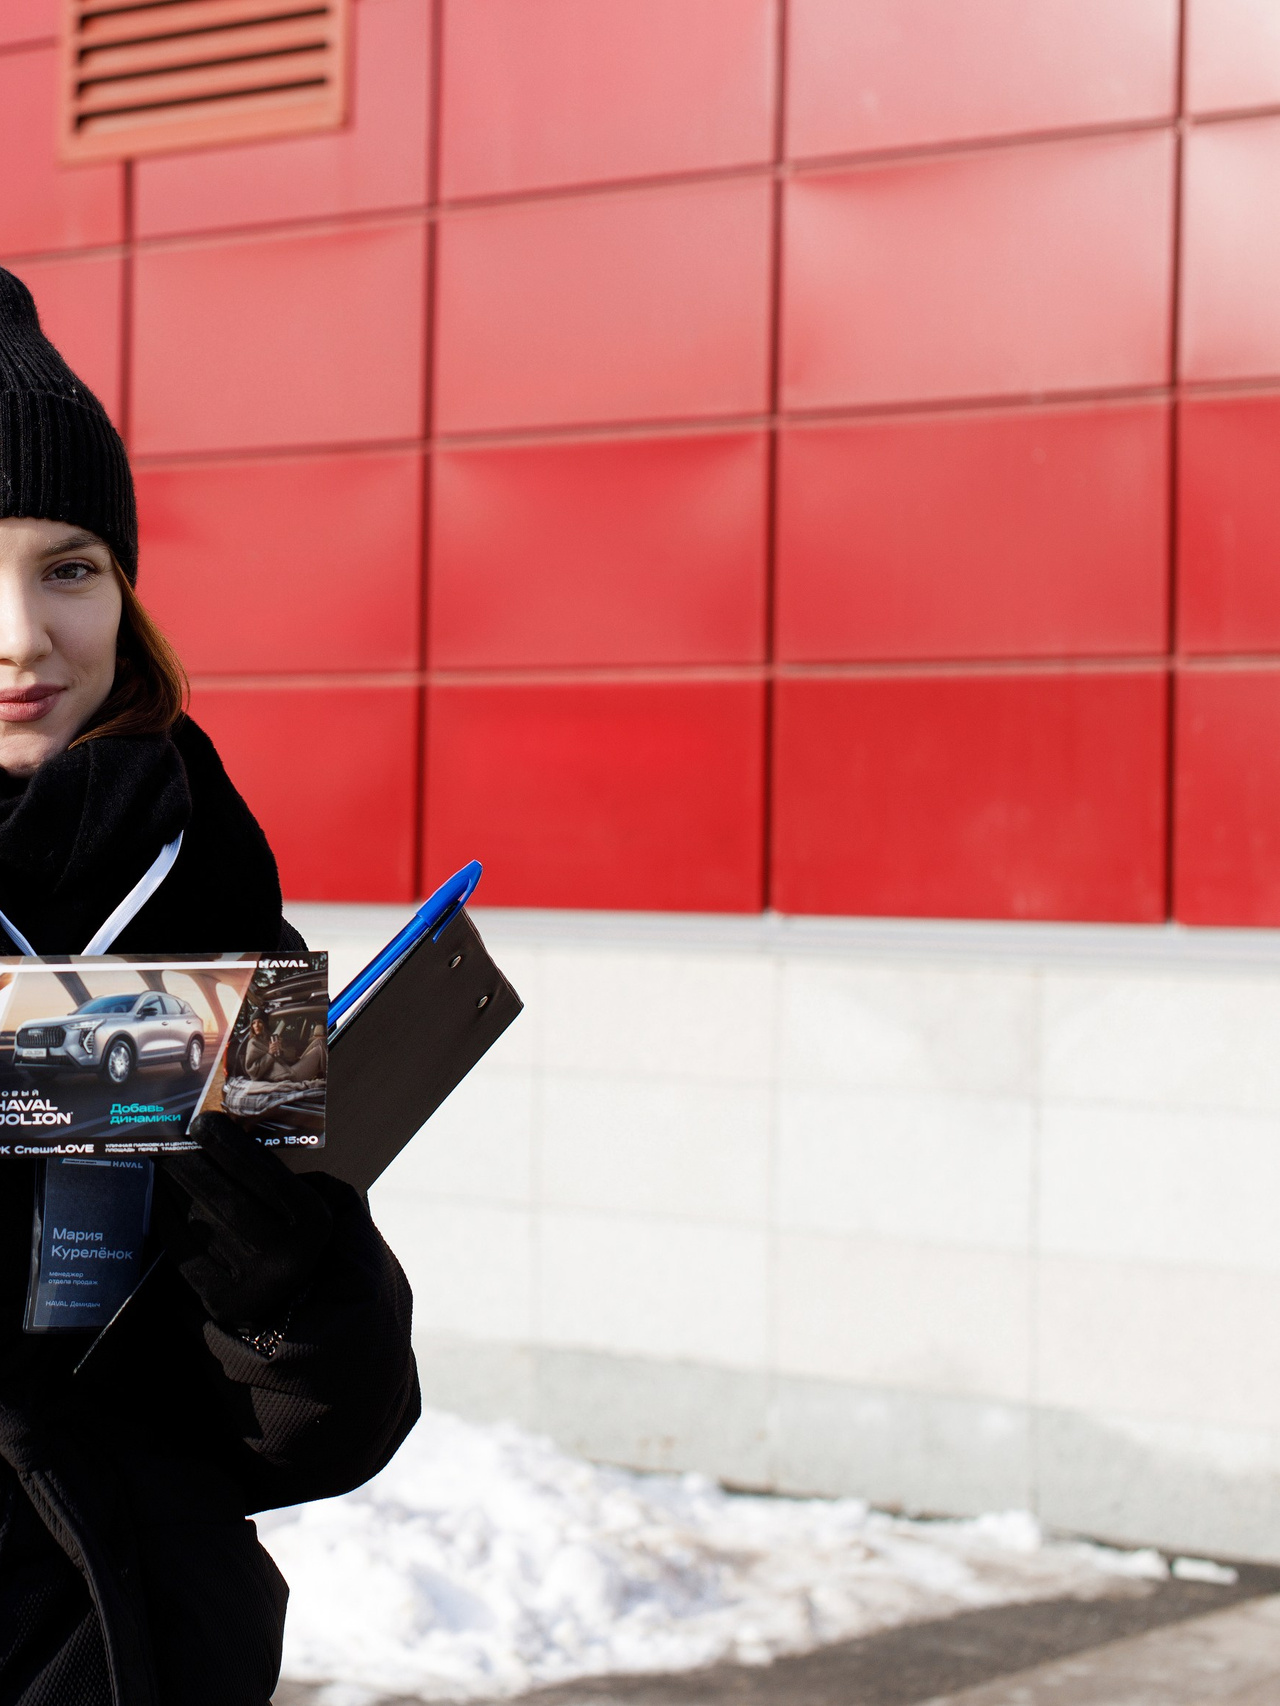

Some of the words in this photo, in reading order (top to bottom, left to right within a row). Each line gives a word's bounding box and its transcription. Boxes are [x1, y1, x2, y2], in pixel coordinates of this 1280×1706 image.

[258, 959, 309, 969] HAVAL
[110, 1102, 164, 1115] Добавь
[109, 1112, 182, 1125] динамики
[264, 1138, 281, 1147] до
[283, 1135, 319, 1145] 15:00
[112, 1160, 144, 1169] HAVAL
[52, 1227, 103, 1244] Мария
[51, 1245, 134, 1260] Курелёнок
[48, 1271, 84, 1279] менеджер
